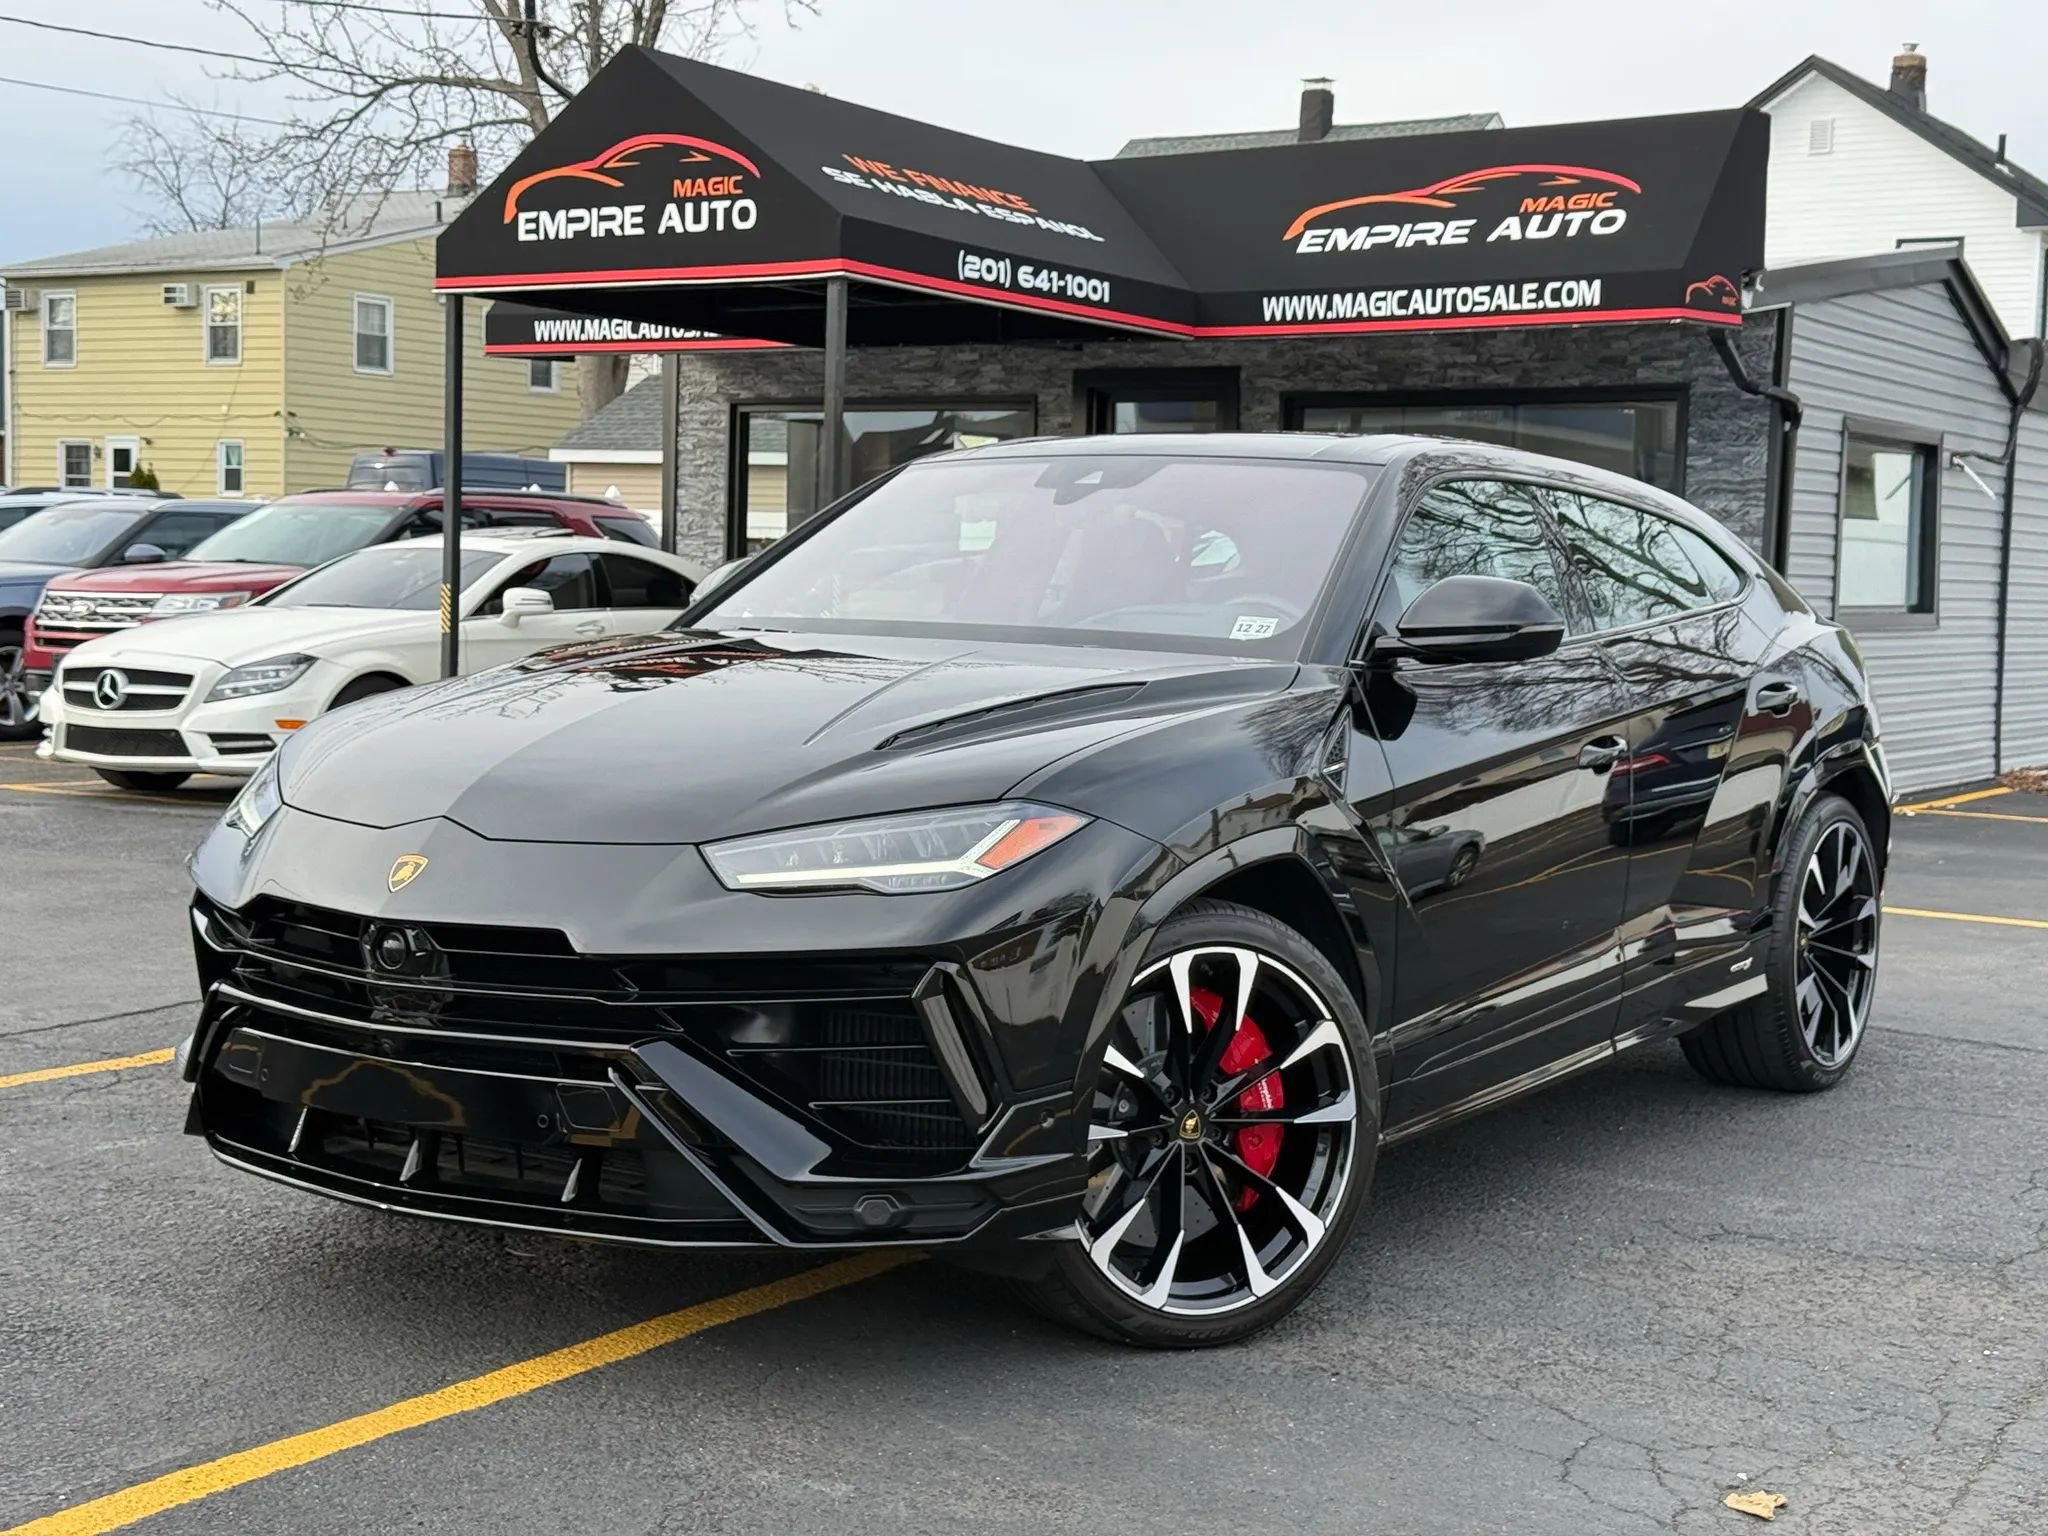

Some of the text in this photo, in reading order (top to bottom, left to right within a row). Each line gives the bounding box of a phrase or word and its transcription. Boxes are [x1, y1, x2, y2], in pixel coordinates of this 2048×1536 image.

[673, 175, 743, 198] MAGIC
[821, 166, 873, 189] SE
[870, 178, 979, 214] HABLA
[842, 153, 1038, 213] WE FINANCE
[1520, 191, 1618, 213] MAGIC
[517, 199, 757, 242] EMPIRE AUTO
[1295, 208, 1627, 254] EMPIRE AUTO
[958, 249, 1110, 303] (201) 641-1001
[1263, 279, 1602, 322] WWW.MAGICAUTOSALE.COM
[1236, 623, 1271, 634] 12 27
